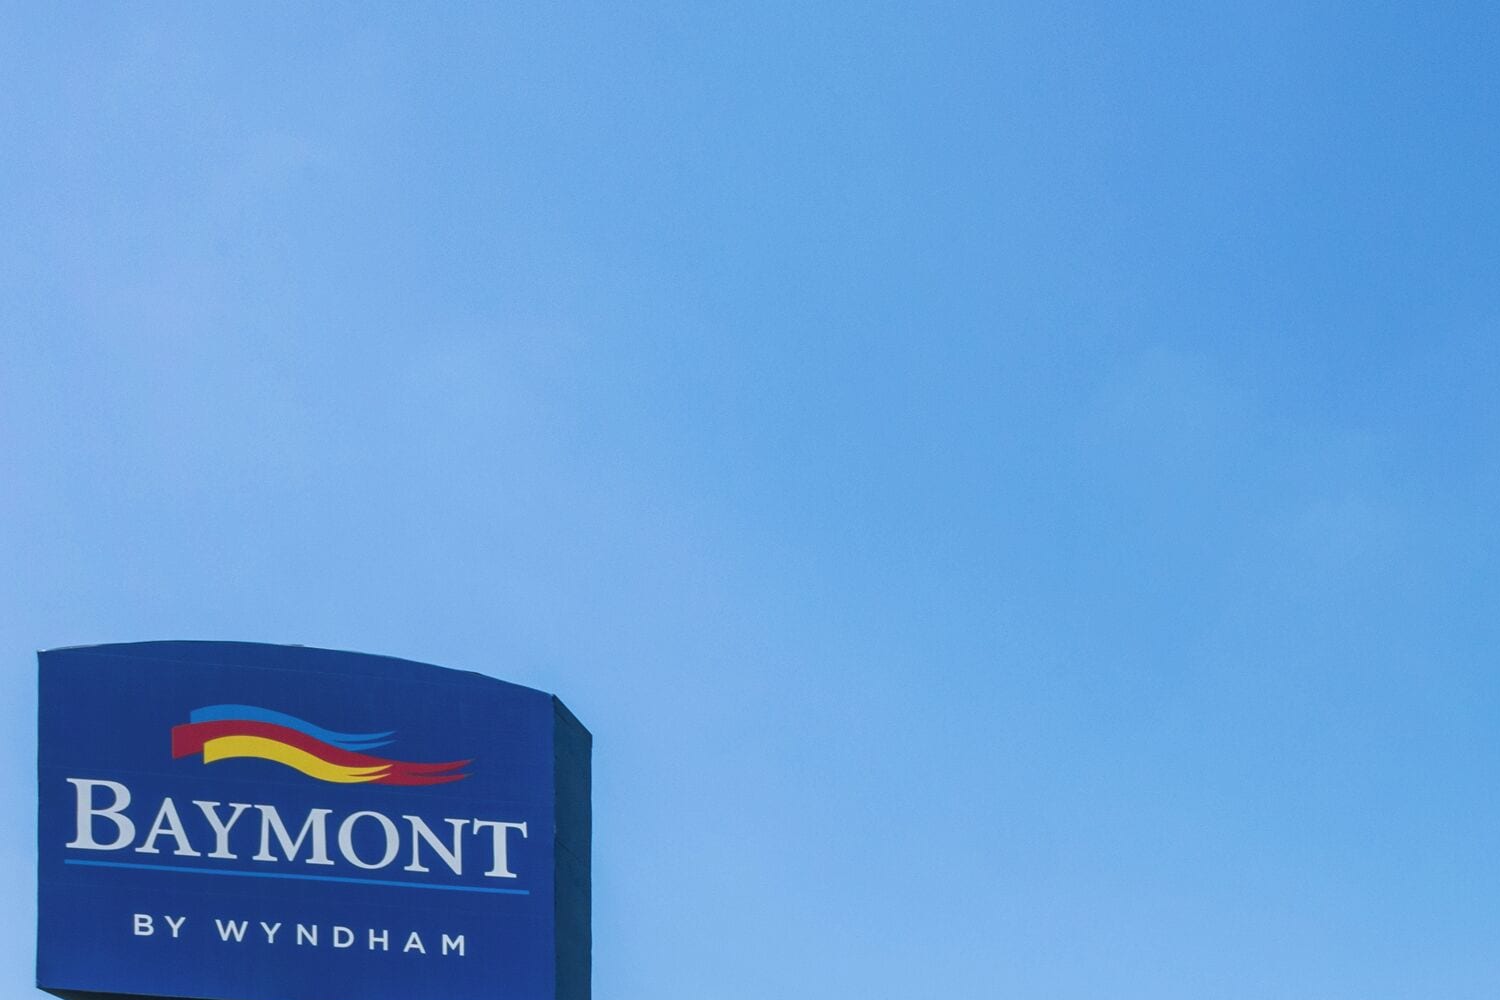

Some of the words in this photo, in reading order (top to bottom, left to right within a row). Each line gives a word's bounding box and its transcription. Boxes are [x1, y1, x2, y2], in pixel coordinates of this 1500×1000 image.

[65, 777, 528, 879] BAYMONT
[133, 913, 187, 938] BY
[215, 918, 466, 957] WYNDHAM
